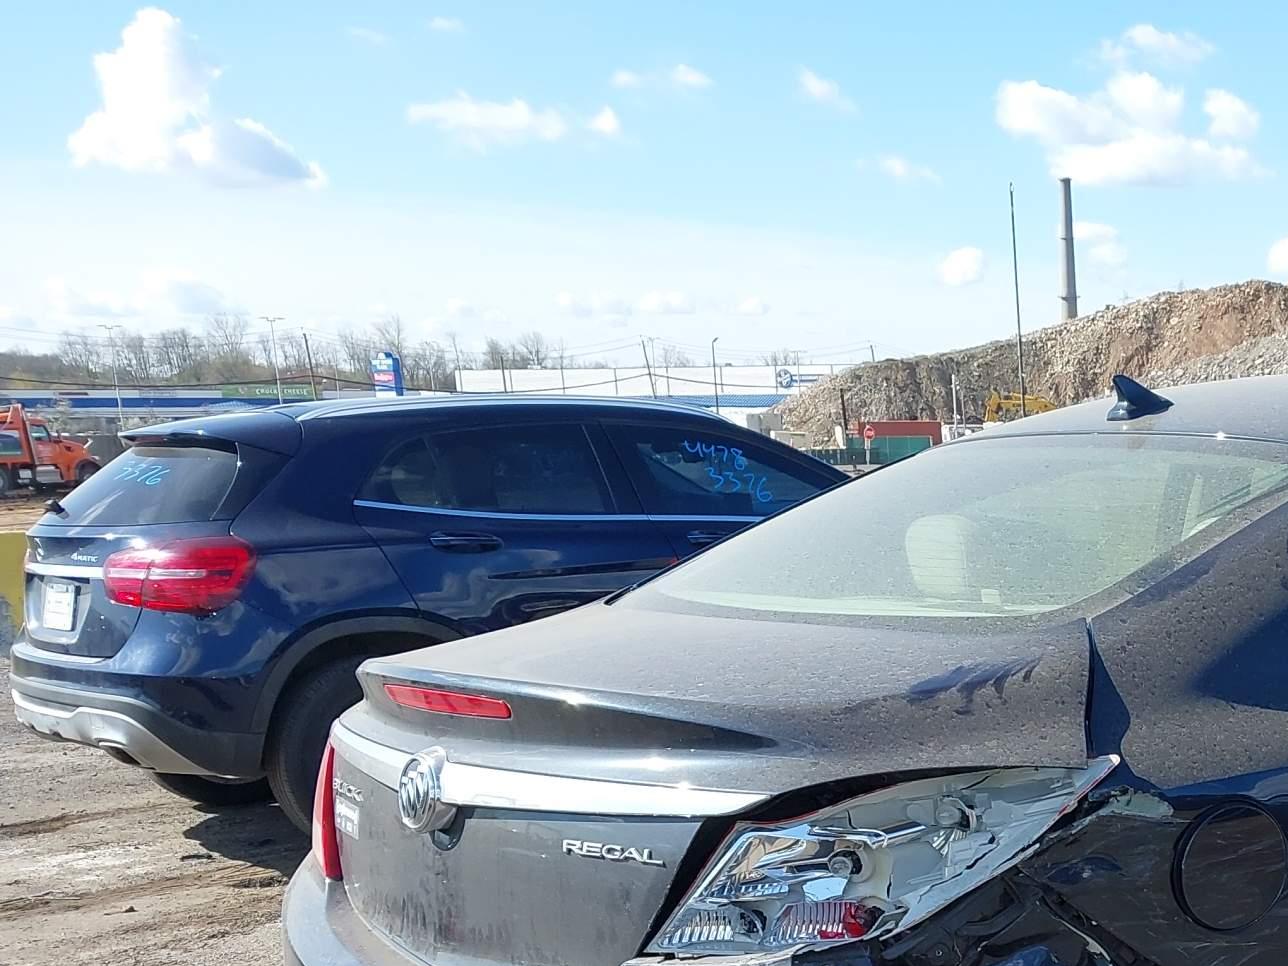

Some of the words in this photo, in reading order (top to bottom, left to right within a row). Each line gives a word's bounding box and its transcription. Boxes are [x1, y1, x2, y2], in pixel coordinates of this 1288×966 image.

[681, 440, 746, 470] 4478
[704, 467, 774, 502] 3376
[562, 839, 665, 866] REGAL
